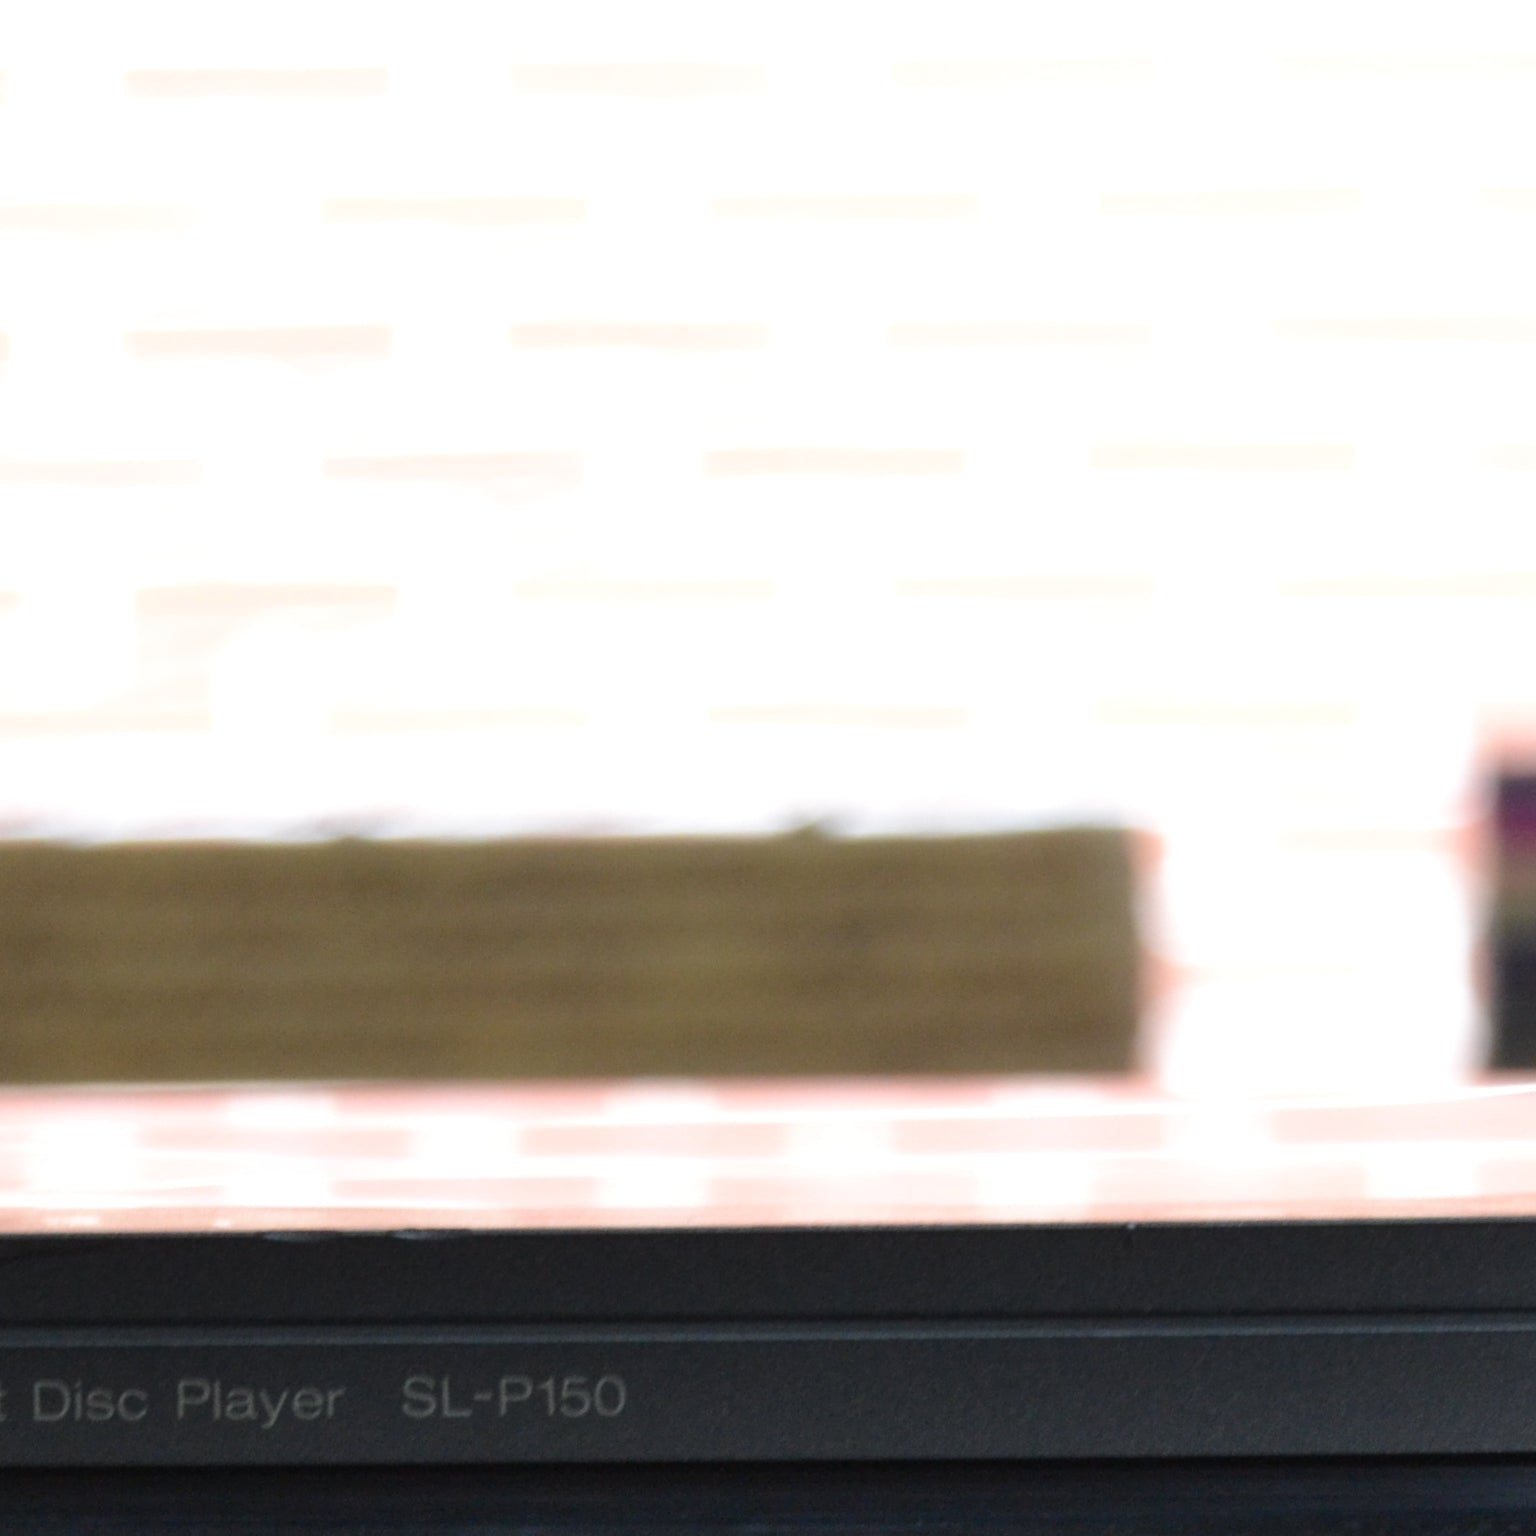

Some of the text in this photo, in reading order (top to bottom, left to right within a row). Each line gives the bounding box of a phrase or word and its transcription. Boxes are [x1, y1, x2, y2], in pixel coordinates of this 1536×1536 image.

[32, 1379, 148, 1424] Disc
[176, 1377, 345, 1428] Player
[400, 1374, 628, 1420] SL-P150
